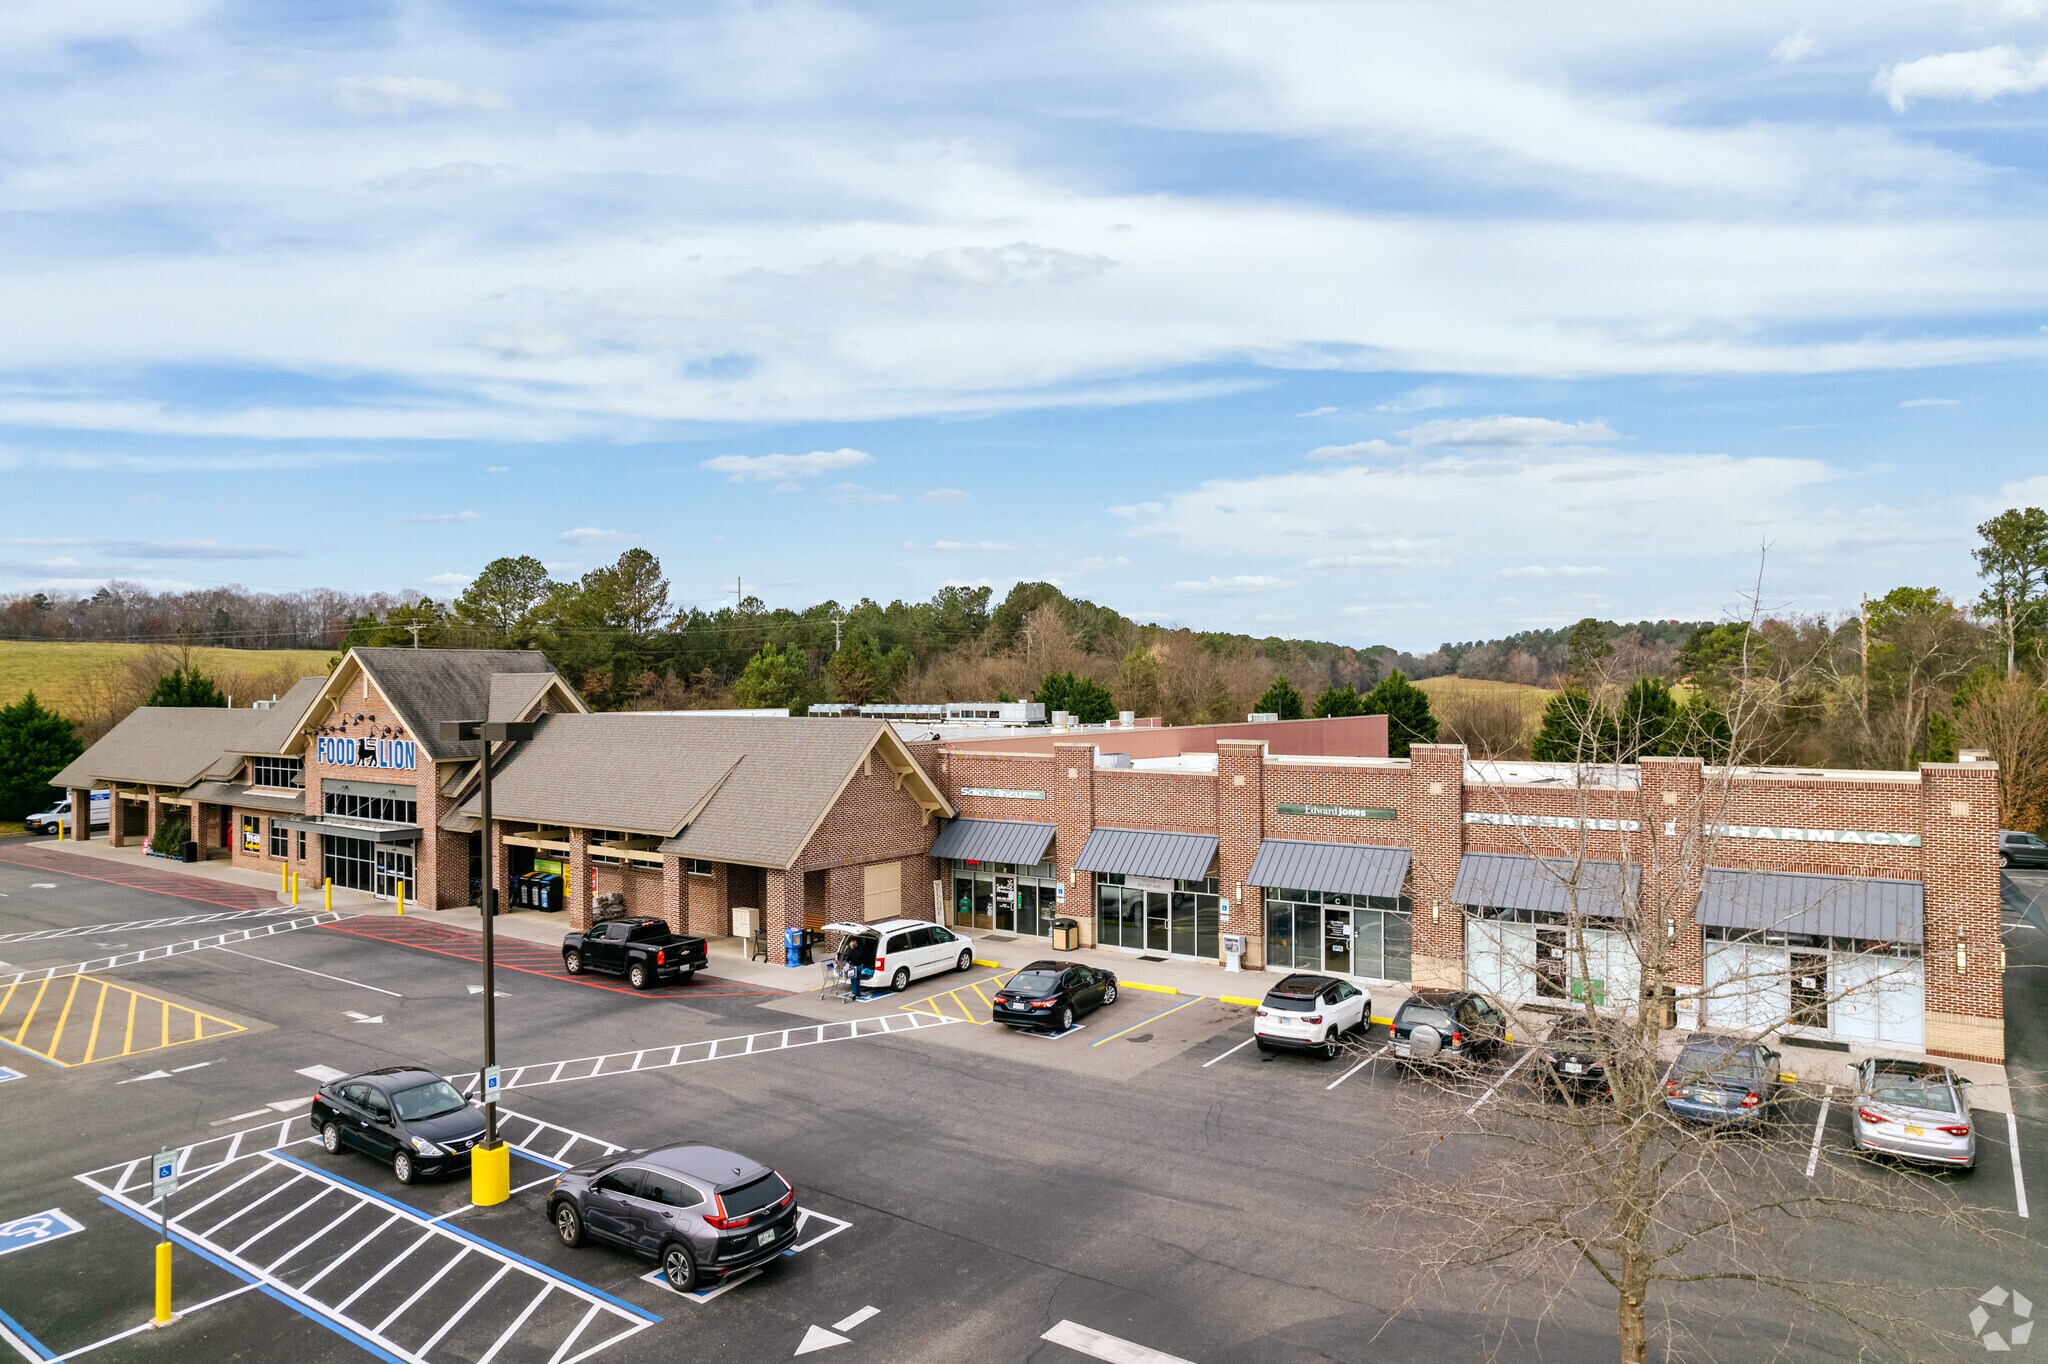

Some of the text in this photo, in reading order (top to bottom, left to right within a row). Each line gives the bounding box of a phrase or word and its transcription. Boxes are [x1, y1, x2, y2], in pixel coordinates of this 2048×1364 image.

[318, 737, 416, 769] FOOD LION
[960, 787, 1039, 799] Salon Anew
[1465, 813, 1919, 846] PREFERRED PHARMACY
